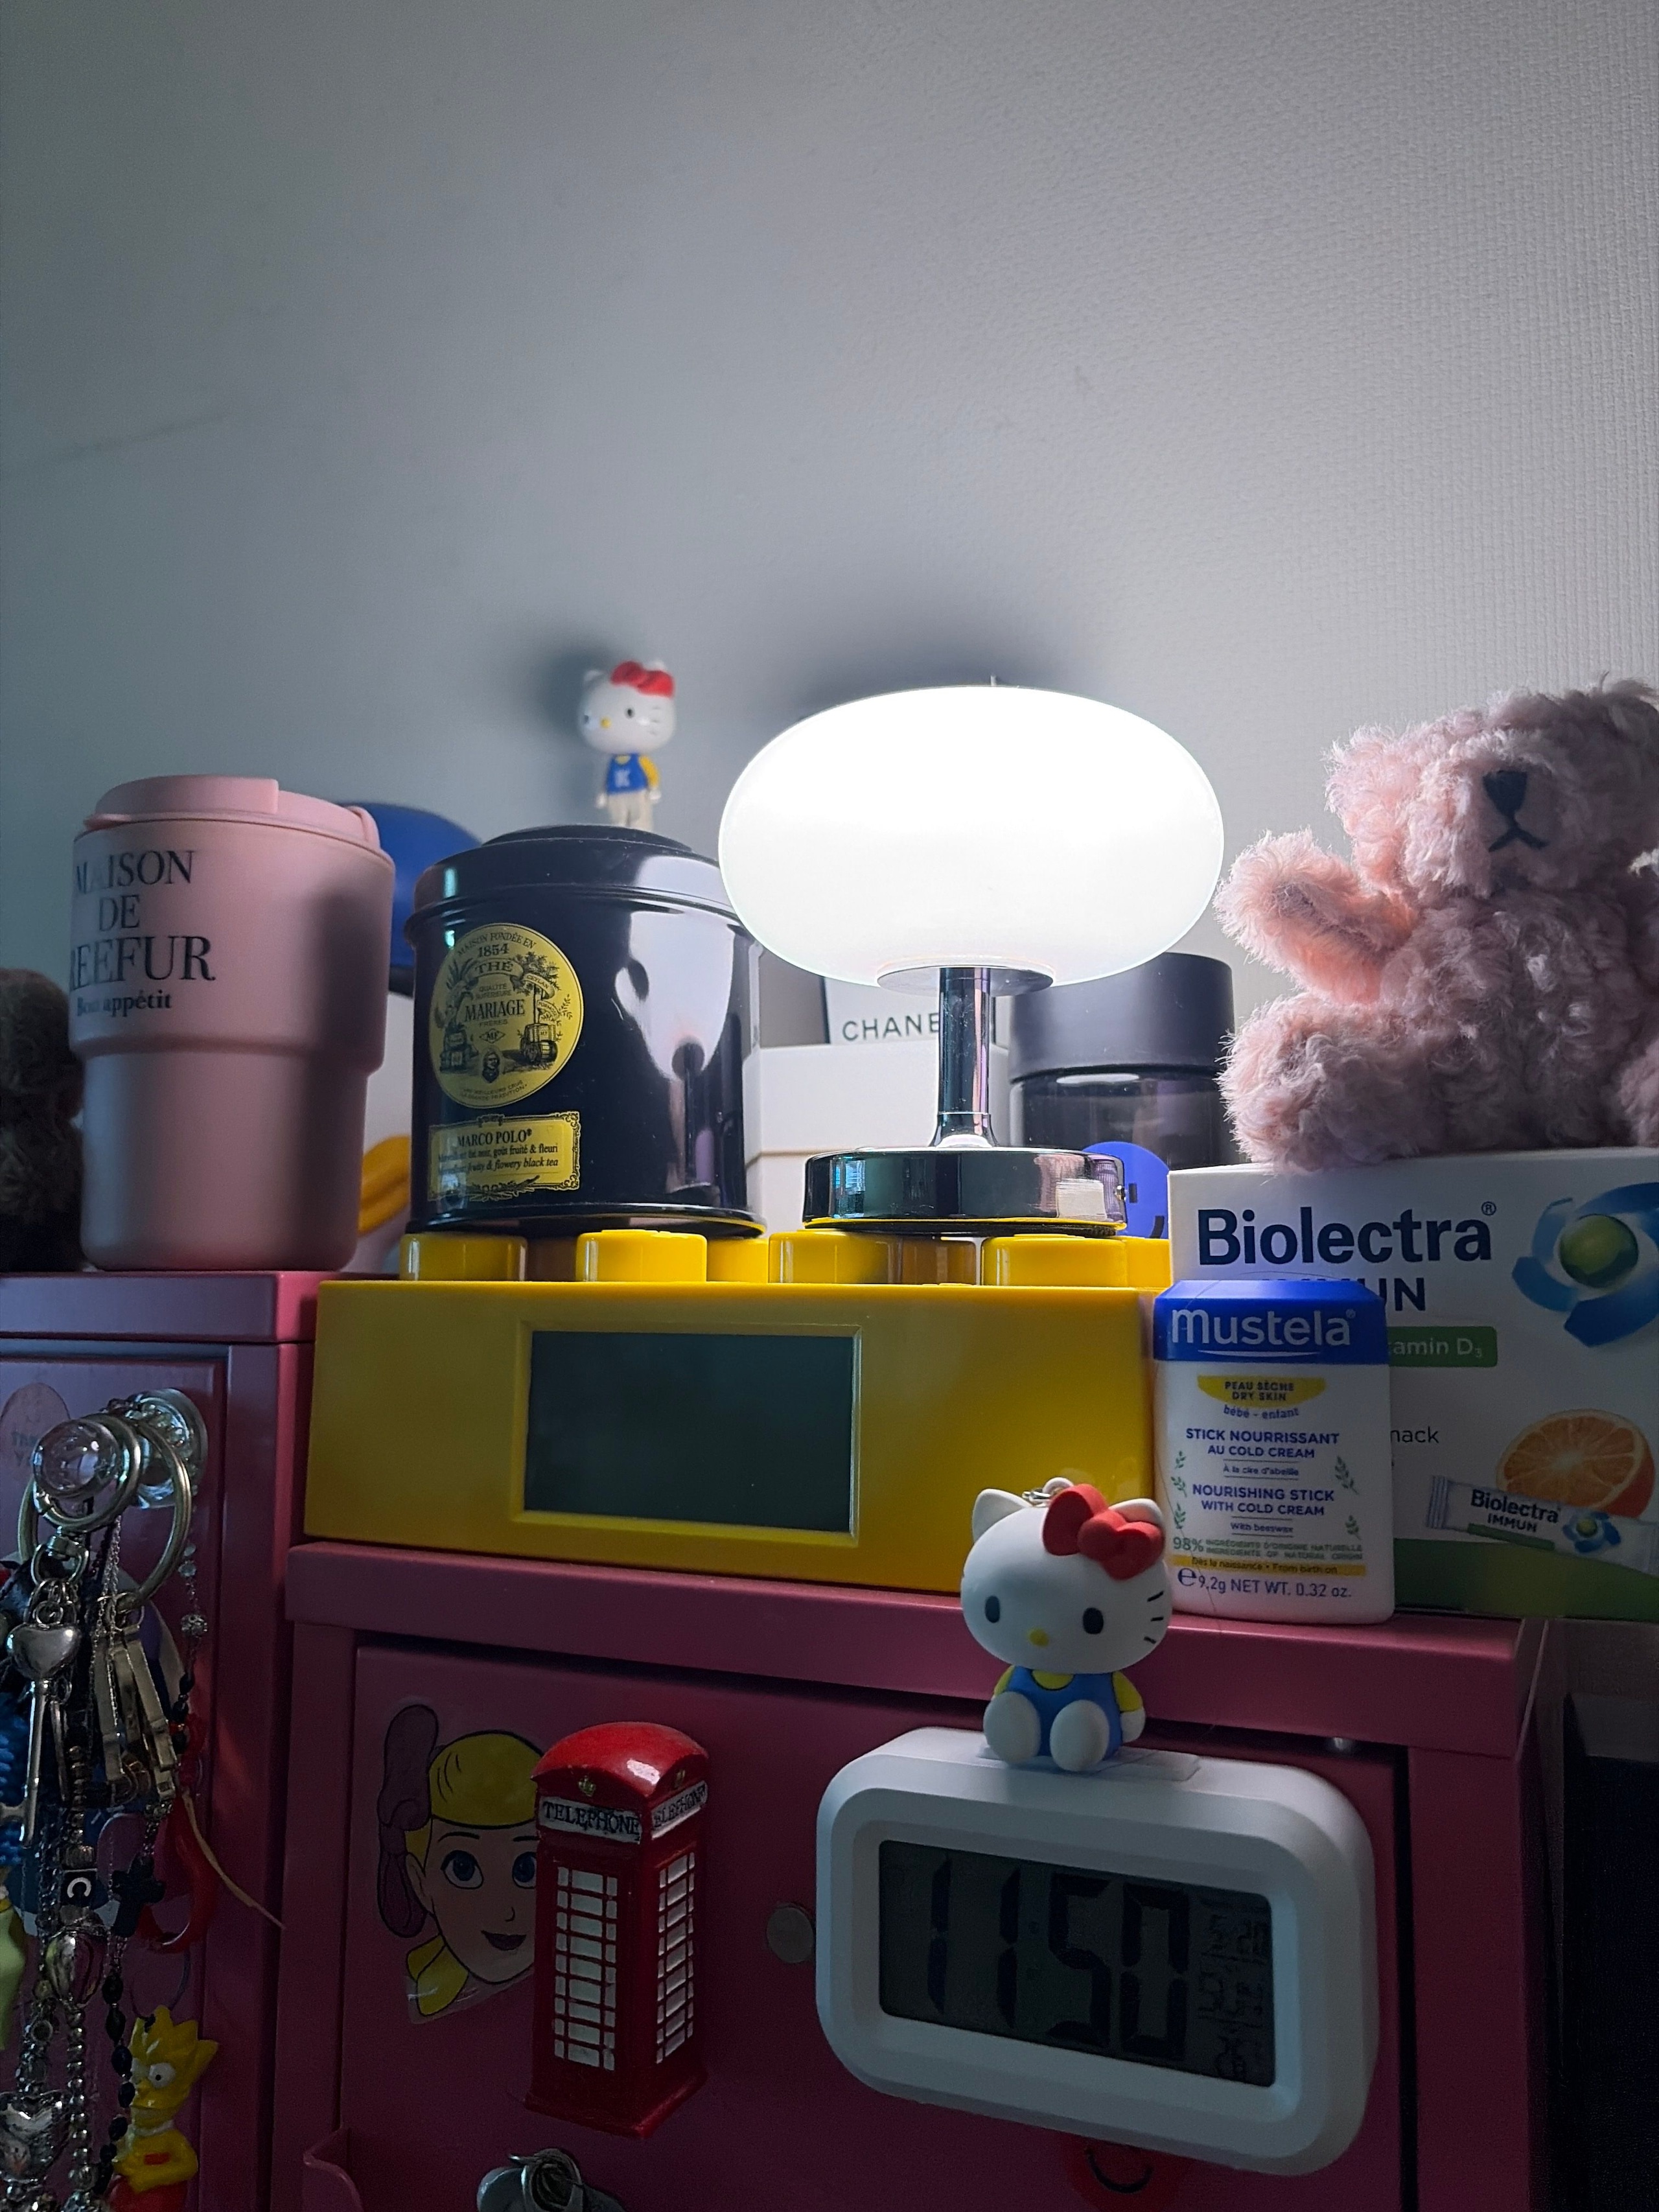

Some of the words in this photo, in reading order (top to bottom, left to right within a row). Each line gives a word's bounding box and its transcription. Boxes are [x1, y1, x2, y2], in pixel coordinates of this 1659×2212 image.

[614, 769, 631, 787] K
[76, 850, 196, 895] MISON
[99, 894, 140, 932] DE
[478, 943, 509, 958] 1854
[523, 937, 537, 949] EN
[474, 960, 514, 974] THÉ
[464, 999, 525, 1022] MARIAGE
[458, 1132, 493, 1147] MARCO
[529, 1144, 536, 1154] &
[539, 1143, 558, 1153] fleuri
[524, 1158, 545, 1168] black
[546, 1158, 558, 1167] tea
[1225, 1381, 1253, 1391] PEAU
[1232, 1391, 1253, 1401] DRY
[1259, 1391, 1286, 1402] SKIN
[1262, 1407, 1300, 1419] enfant
[1185, 1428, 1225, 1441] STICK
[1229, 1430, 1340, 1445] NOURRISSANT
[1207, 1445, 1225, 1455] AU
[1229, 1445, 1264, 1457] COLD
[1268, 1447, 1315, 1458] CREAM
[1192, 1484, 1285, 1500] NOURISHING
[1290, 1489, 1334, 1502] STICK
[1201, 1500, 1234, 1512] WITH
[1237, 1503, 1273, 1514] COLD
[1277, 1504, 1325, 1515] CREAM
[1487, 1513, 1538, 1533] IMMUN
[1173, 1537, 1204, 1553] 98%
[1231, 1579, 1260, 1593] NET
[1265, 1581, 1291, 1596] WT.
[1296, 1583, 1327, 1598] 0.32
[1331, 1587, 1352, 1598] oz.
[543, 1801, 640, 1835] TELEPHONE
